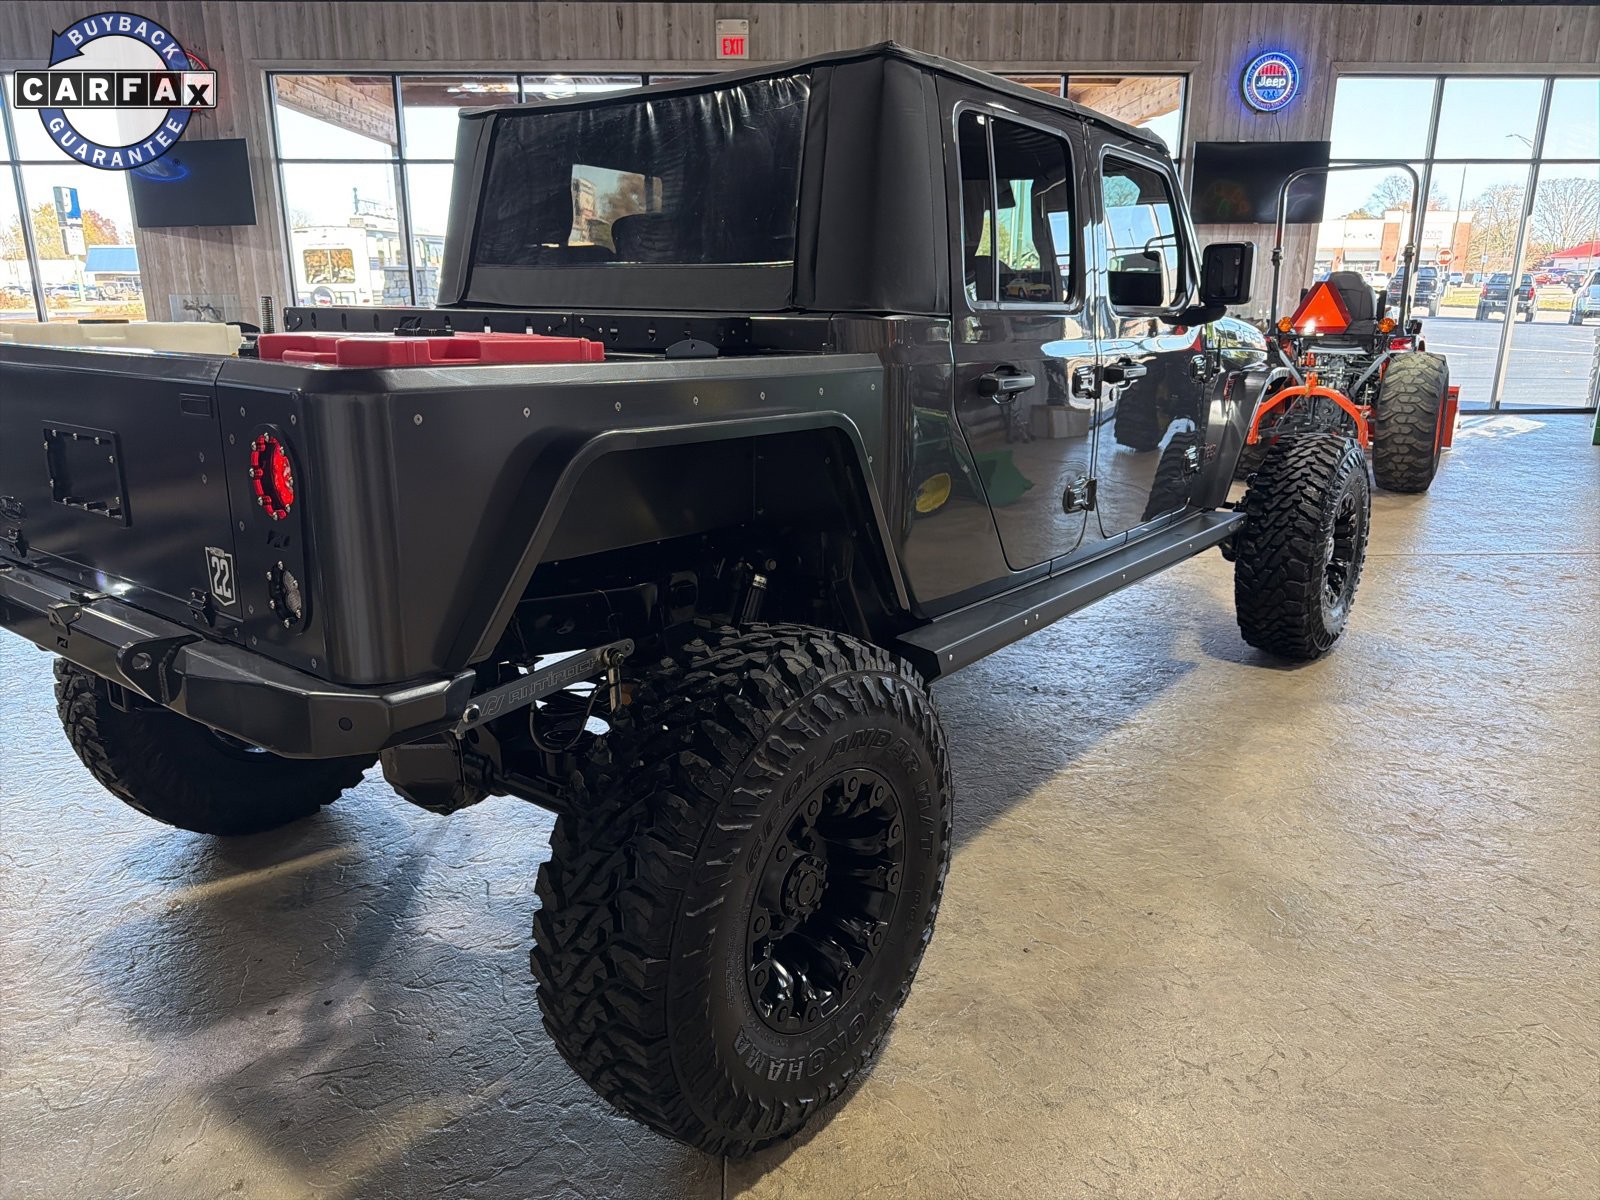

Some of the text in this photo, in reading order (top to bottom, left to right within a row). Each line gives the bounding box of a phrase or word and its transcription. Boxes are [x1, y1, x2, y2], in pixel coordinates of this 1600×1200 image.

[721, 37, 744, 56] EXIT
[1256, 76, 1286, 88] Jeep
[211, 556, 232, 599] 22
[747, 728, 921, 873] GEOLANDAR
[733, 992, 885, 1083] YOKOHAMA
